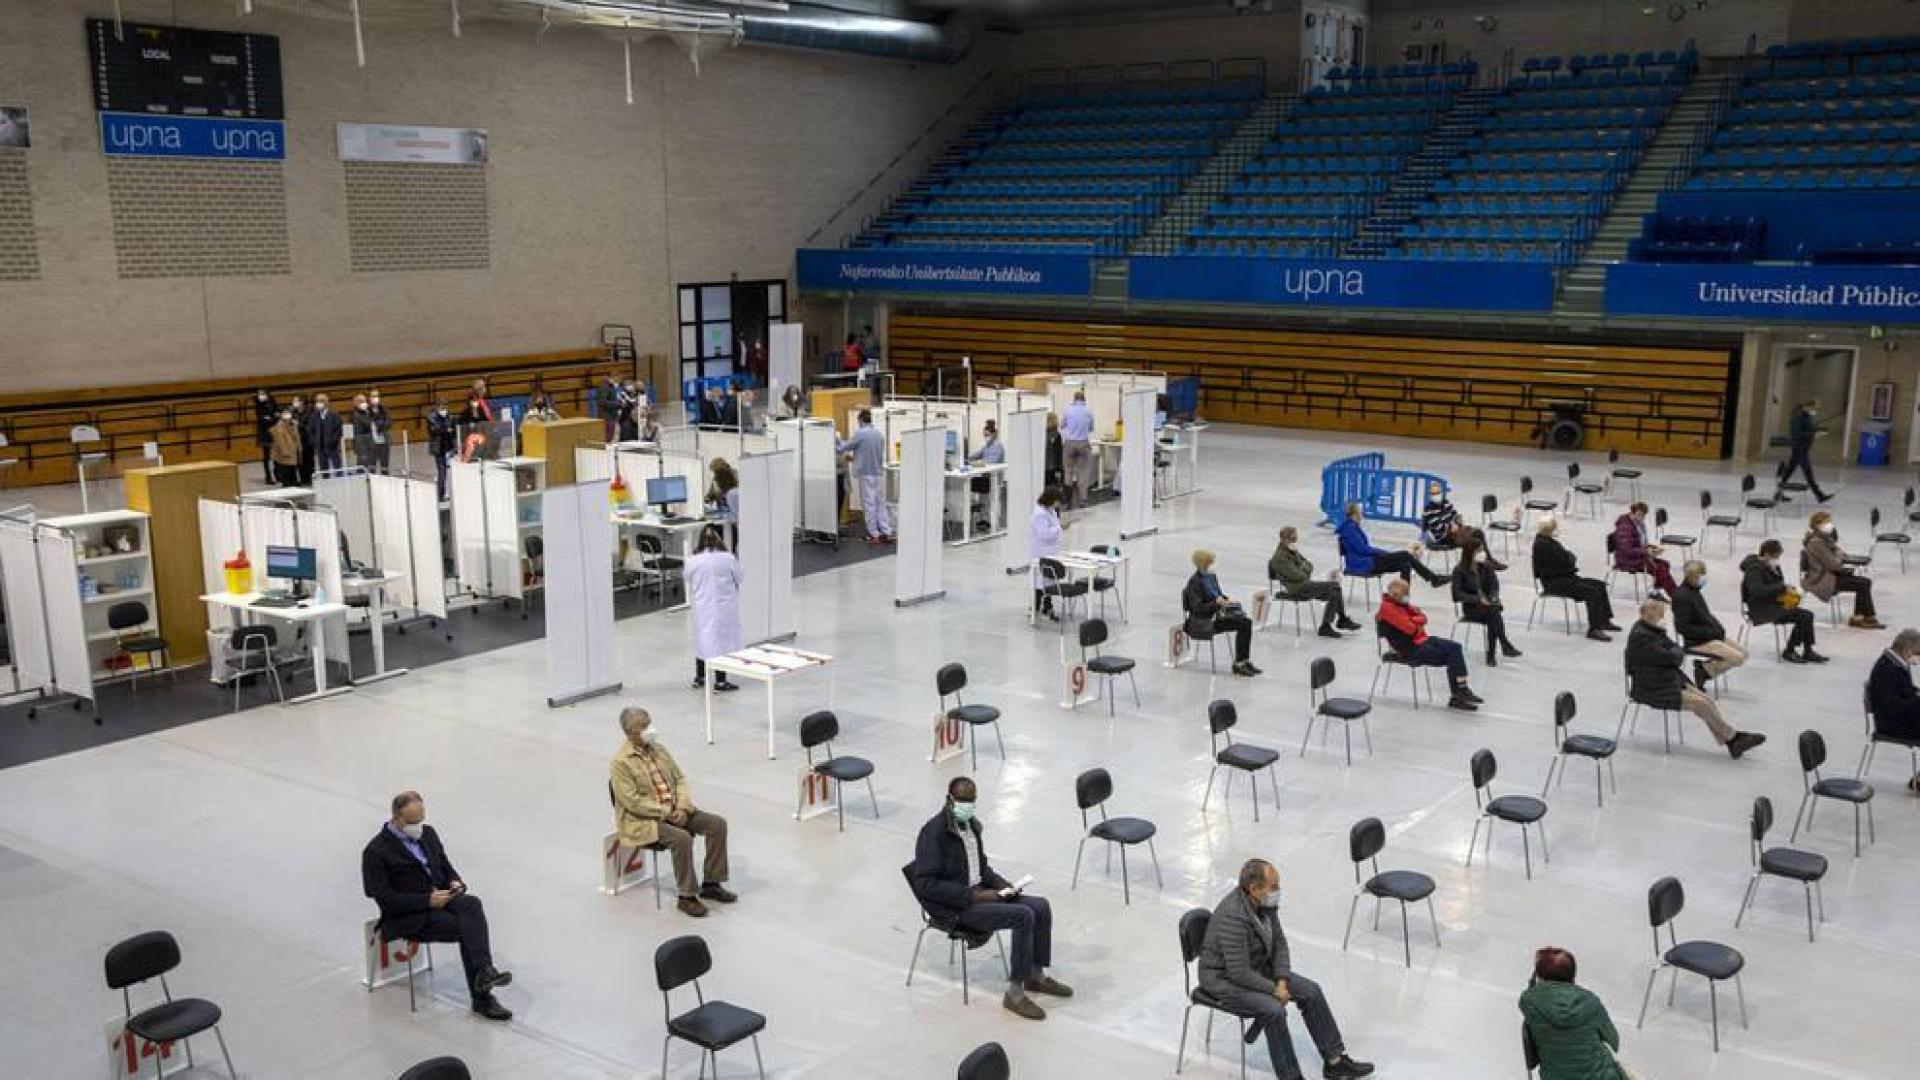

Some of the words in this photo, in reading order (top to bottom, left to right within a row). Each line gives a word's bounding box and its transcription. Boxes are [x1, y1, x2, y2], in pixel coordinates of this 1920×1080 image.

[111, 123, 181, 151] upna
[212, 128, 276, 154] upna
[839, 263, 905, 280] Nafarroako
[905, 264, 983, 282] Unibertsitate
[986, 266, 1040, 283] Publikoa
[1285, 267, 1364, 300] upna
[1699, 282, 1834, 305] Universidad
[1841, 284, 1920, 307] Públic
[1072, 665, 1085, 694] 9
